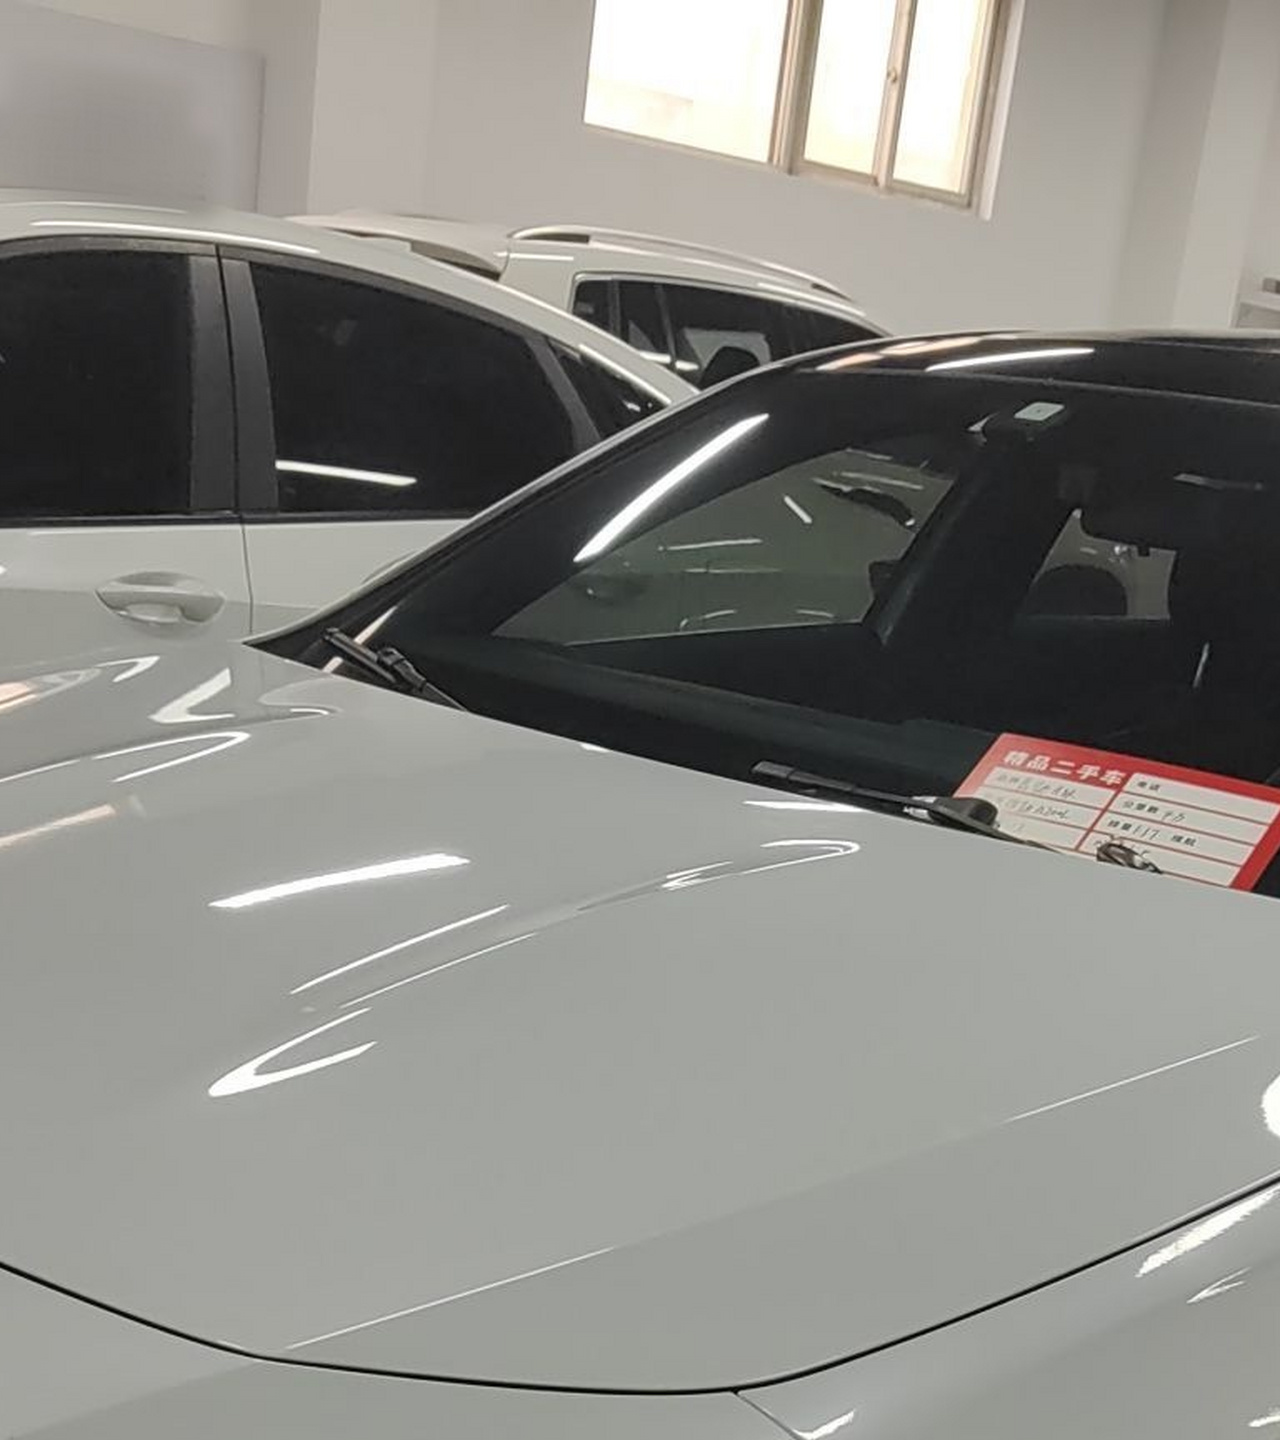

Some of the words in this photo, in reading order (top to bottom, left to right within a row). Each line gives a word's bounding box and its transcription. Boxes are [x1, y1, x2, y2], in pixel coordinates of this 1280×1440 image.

[1003, 750, 1128, 786] 精品二手车
